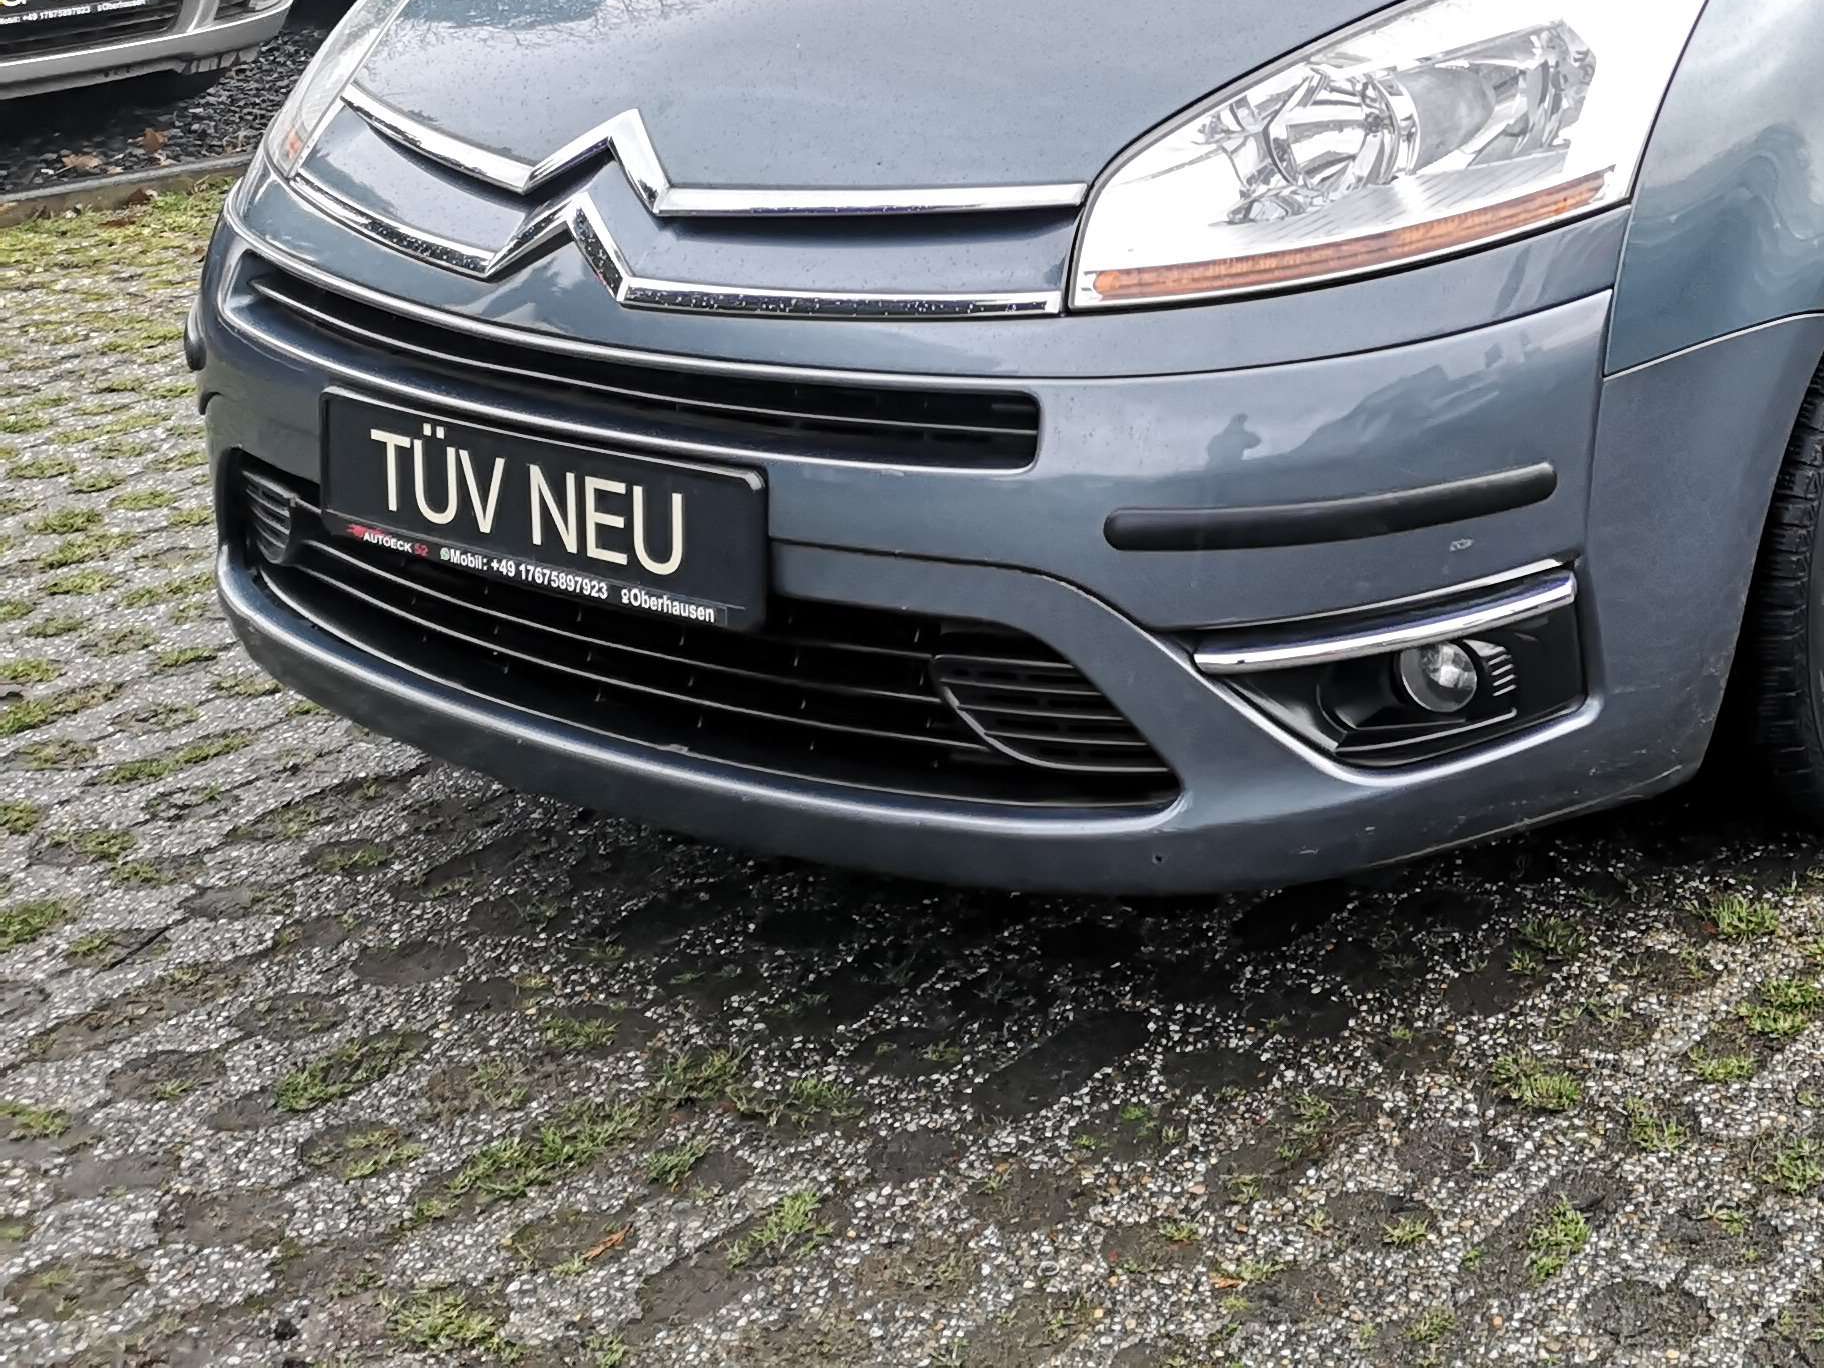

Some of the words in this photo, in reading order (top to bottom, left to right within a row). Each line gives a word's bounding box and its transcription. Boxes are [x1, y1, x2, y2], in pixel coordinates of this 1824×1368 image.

[370, 422, 506, 535] TÜV
[527, 462, 683, 576] NEU
[363, 531, 413, 554] AUTOECK
[450, 549, 488, 571] Mobil:
[491, 559, 515, 578] +49
[518, 565, 609, 599] 17675897923
[631, 588, 716, 623] Oberhausen
